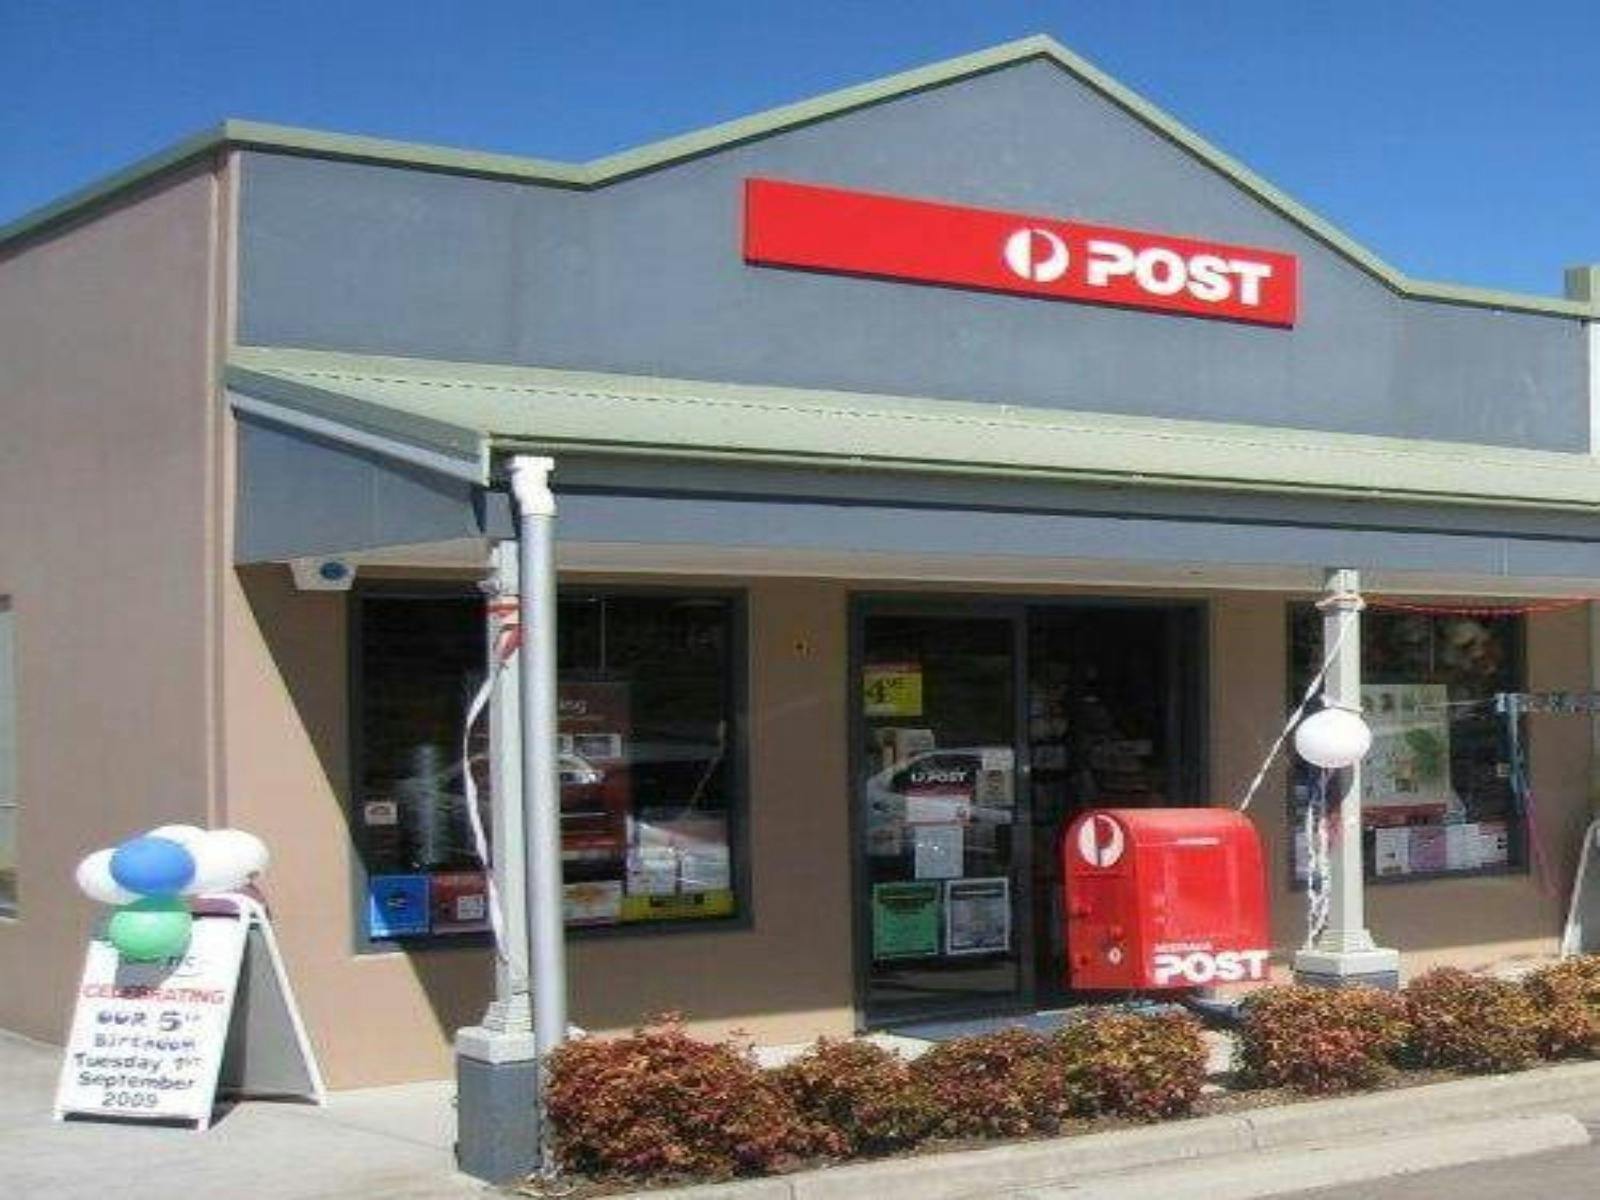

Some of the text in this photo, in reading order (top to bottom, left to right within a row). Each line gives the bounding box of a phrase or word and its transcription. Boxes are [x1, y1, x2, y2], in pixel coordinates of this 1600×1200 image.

[1087, 240, 1272, 306] POST
[1155, 950, 1269, 985] POST
[85, 985, 225, 1004] CELEBRATING
[73, 1053, 162, 1073] Tuesday
[78, 1071, 195, 1090] September
[102, 1091, 158, 1108] 2009
